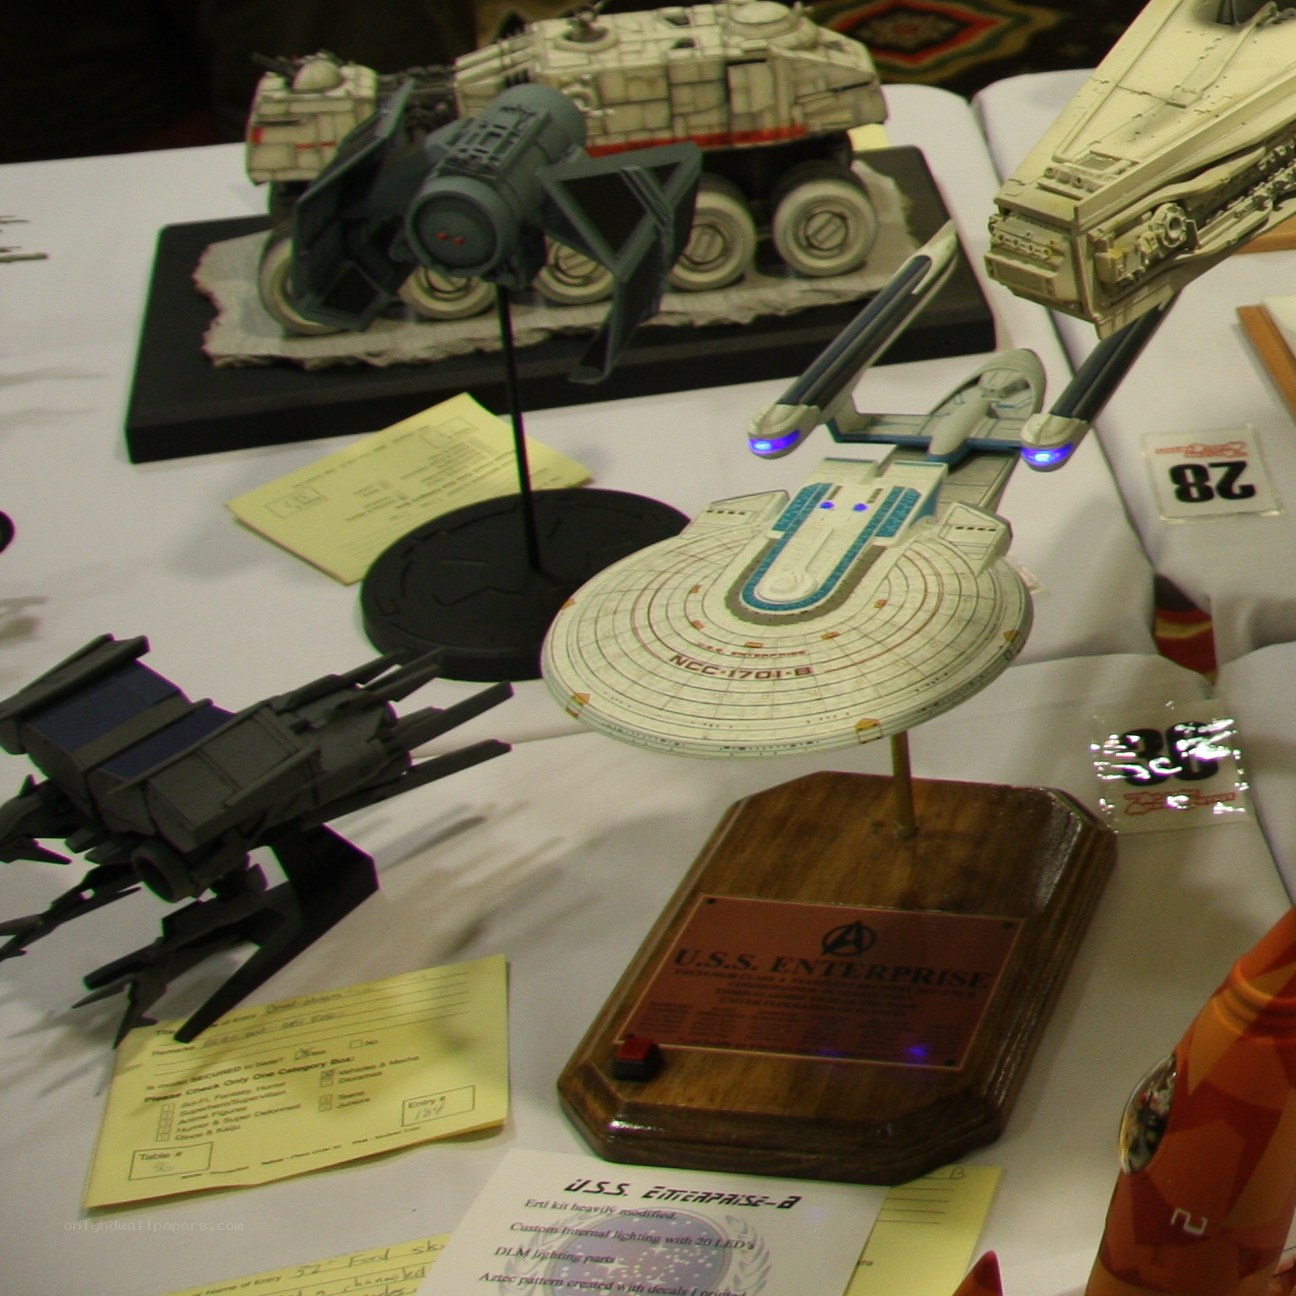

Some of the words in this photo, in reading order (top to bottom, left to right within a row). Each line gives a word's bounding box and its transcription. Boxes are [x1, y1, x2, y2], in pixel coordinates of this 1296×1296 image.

[1169, 461, 1256, 503] 28
[674, 948, 758, 971] U.S.S.
[771, 956, 992, 989] ENTERPRISE
[186, 1083, 220, 1095] Check
[224, 1077, 249, 1087] Only
[252, 1071, 274, 1080] One
[278, 1060, 326, 1076] Category
[408, 1098, 436, 1109] Entry
[140, 1152, 171, 1161] Table
[564, 1178, 630, 1197] U.S.S.
[524, 1198, 550, 1209] Ertl
[550, 1200, 568, 1211] kit
[570, 1201, 616, 1218] heavily
[619, 1207, 676, 1221] modified.
[510, 1221, 559, 1235] Custom
[612, 1228, 662, 1246] lighting
[665, 1232, 692, 1245] with
[695, 1236, 713, 1247] 20
[494, 1245, 532, 1258] DLM
[532, 1248, 582, 1265] lighting
[585, 1253, 616, 1266] parts
[479, 1270, 517, 1284] Aztec
[519, 1274, 563, 1289] pattern
[565, 1278, 614, 1291] created
[616, 1281, 646, 1295] with
[648, 1281, 689, 1296] decals
